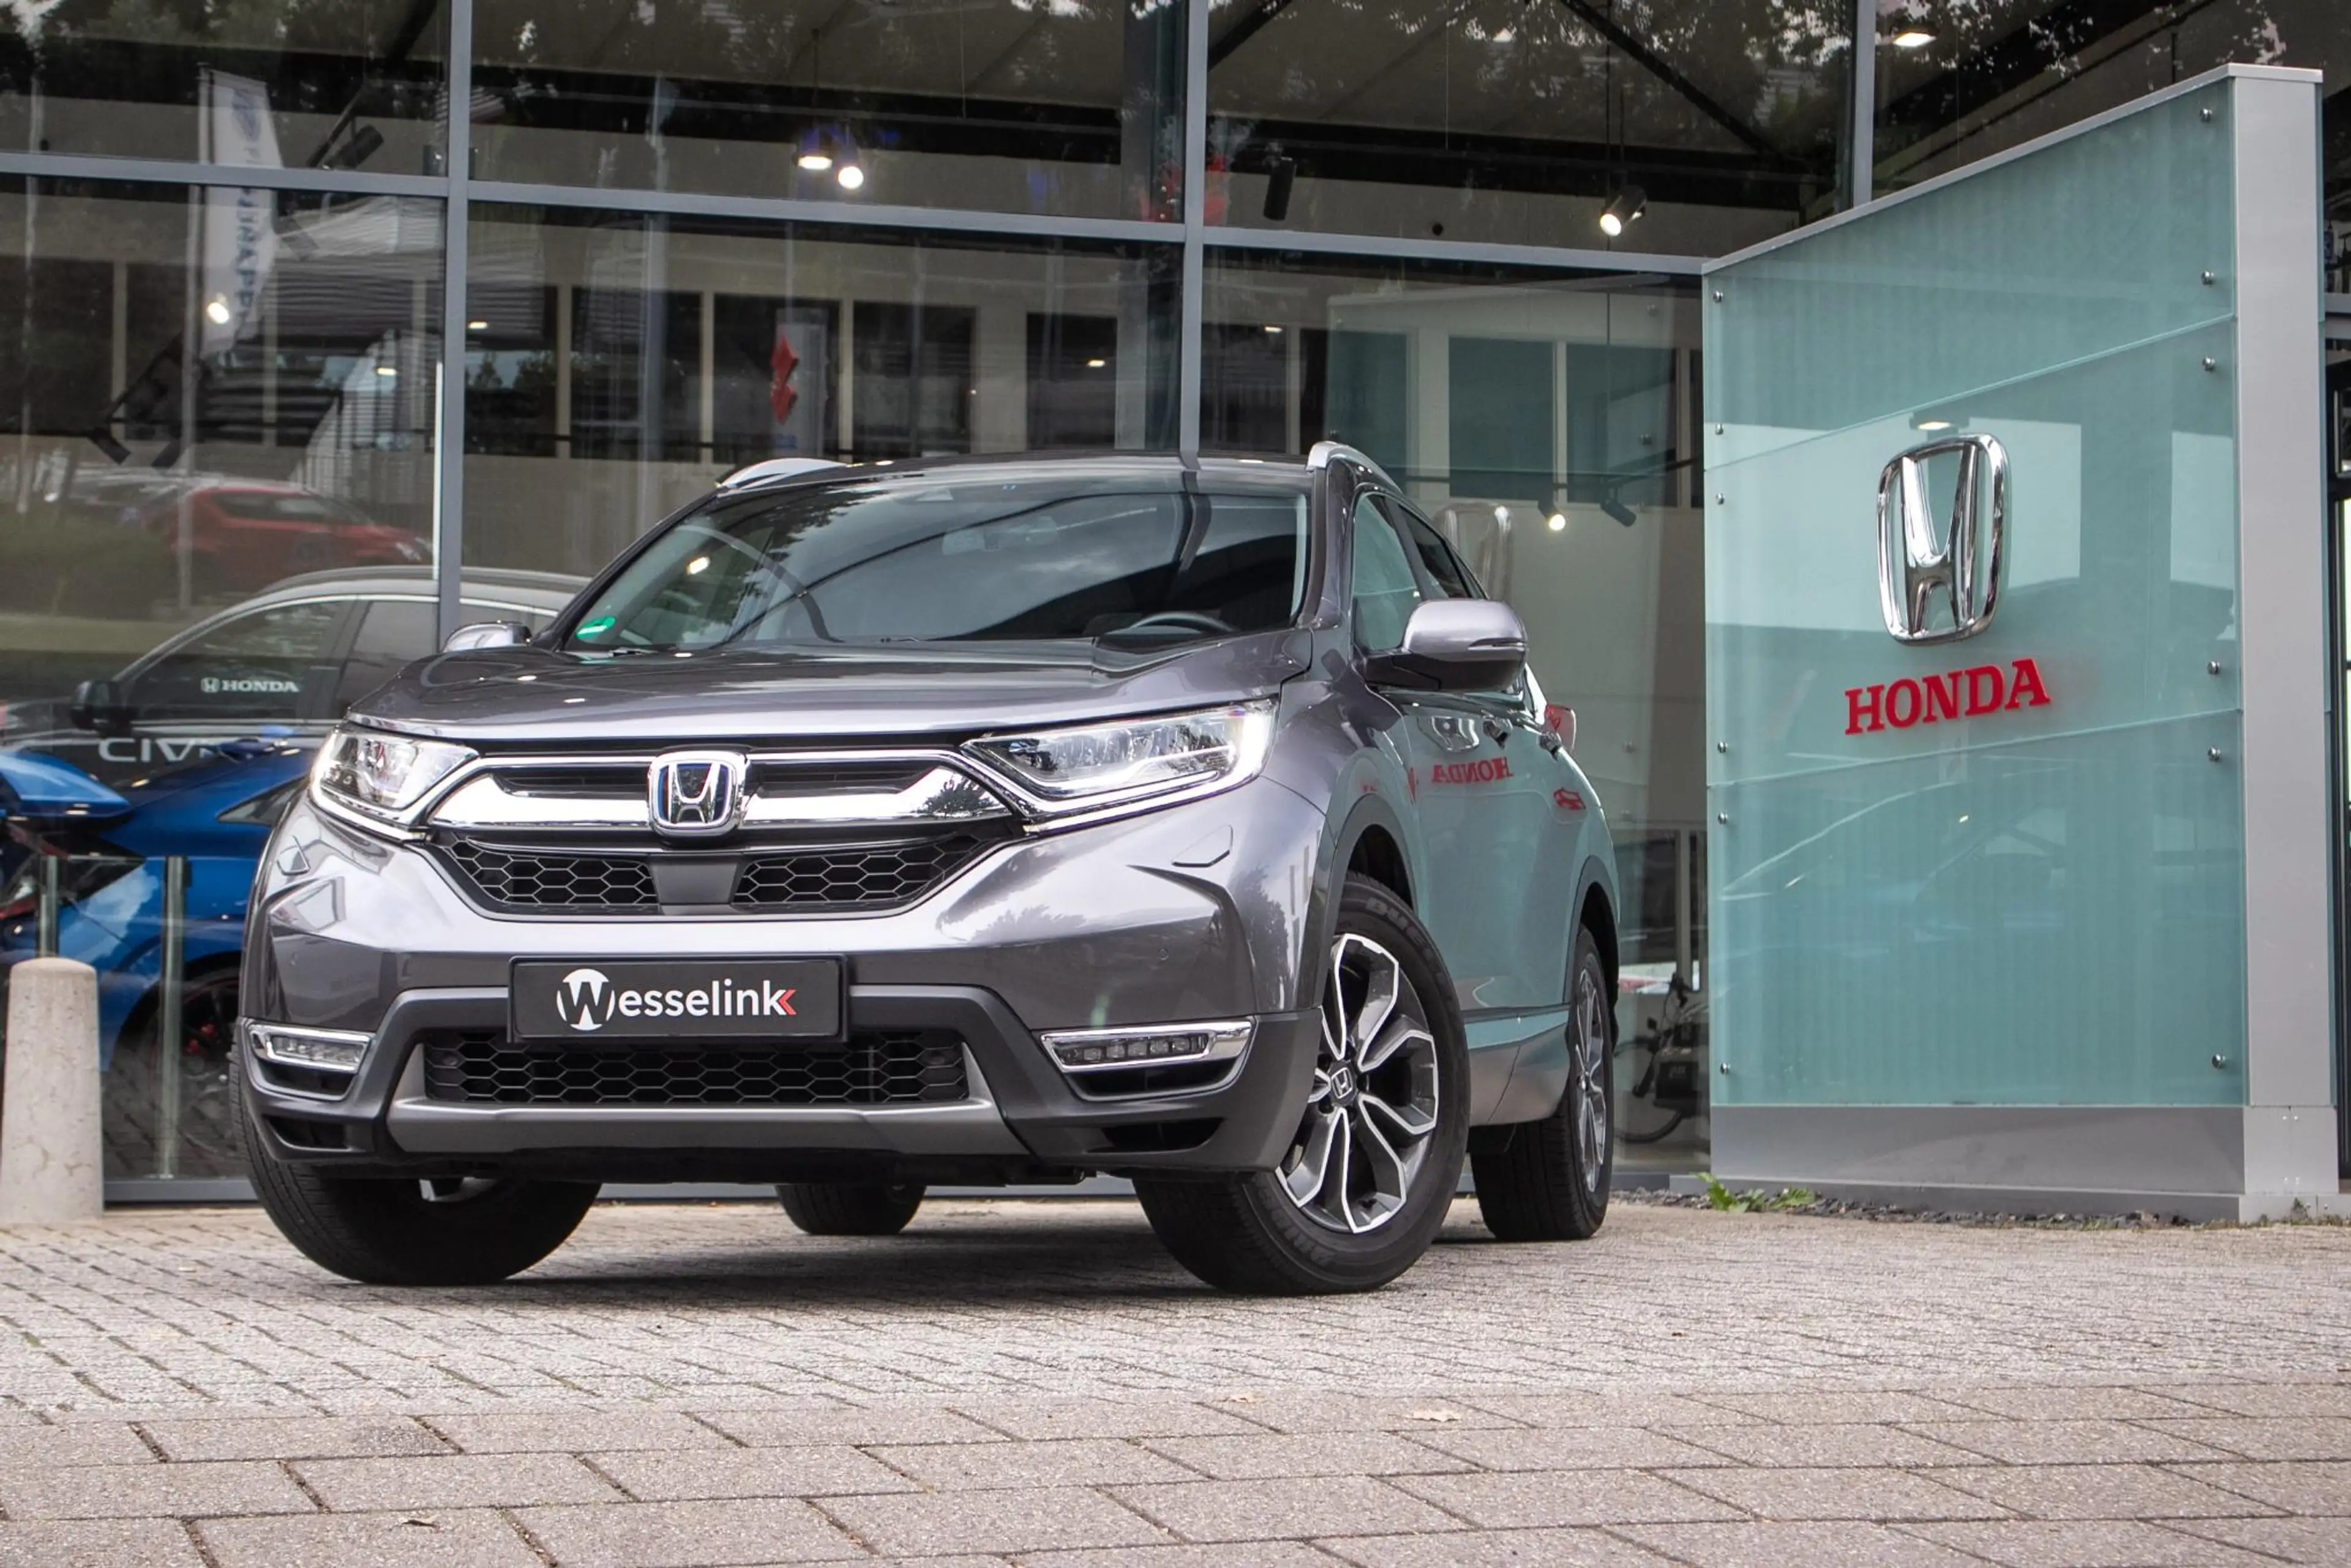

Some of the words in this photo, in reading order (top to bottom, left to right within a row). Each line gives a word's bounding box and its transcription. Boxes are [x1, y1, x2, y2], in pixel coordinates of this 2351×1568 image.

[222, 680, 299, 693] HONDA
[1845, 657, 2051, 735] HONDA
[556, 968, 797, 1031] Wesselink
